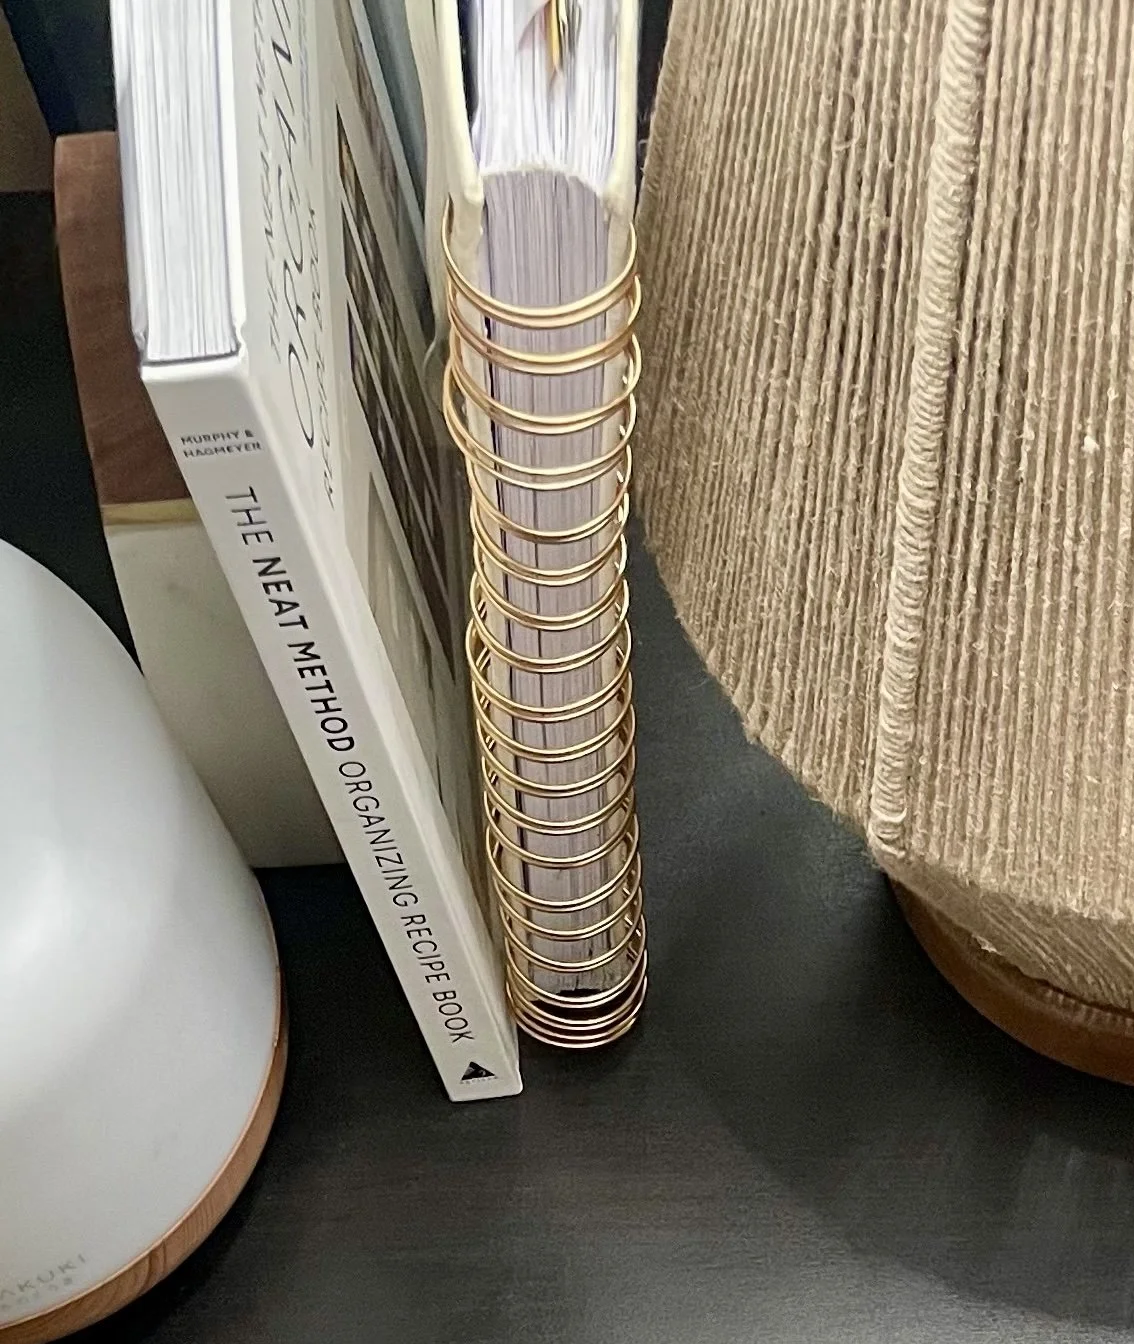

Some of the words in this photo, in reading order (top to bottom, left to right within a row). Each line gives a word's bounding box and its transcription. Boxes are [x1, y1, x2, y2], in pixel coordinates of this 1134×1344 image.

[181, 429, 240, 445] MURPHY
[183, 441, 262, 458] HAGMEYER
[225, 486, 274, 545] THE
[252, 557, 309, 630] NEAT
[287, 641, 355, 752] METHOD
[338, 761, 419, 907] ORGANIZING
[401, 914, 451, 983] RECIPE
[432, 990, 475, 1043] BOOK
